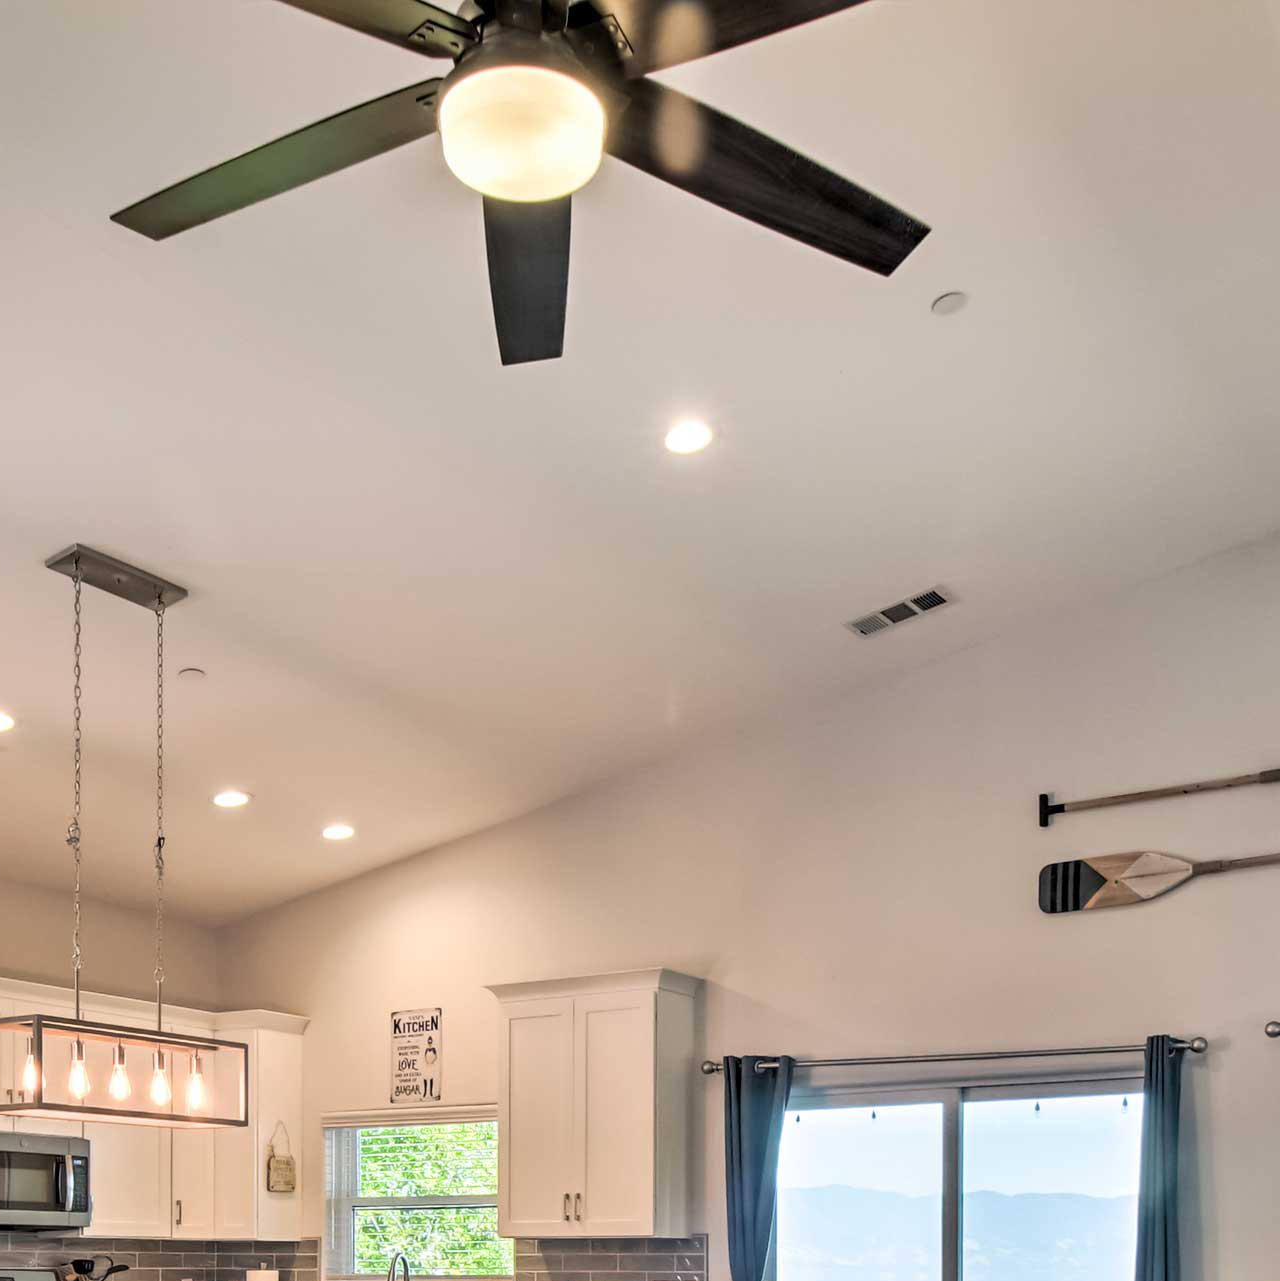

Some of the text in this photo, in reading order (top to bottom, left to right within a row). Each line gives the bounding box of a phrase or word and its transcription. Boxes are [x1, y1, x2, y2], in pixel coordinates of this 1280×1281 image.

[394, 1016, 438, 1034] KITCHEN
[398, 1057, 419, 1071] LOVE
[395, 1084, 421, 1097] SUGAR
